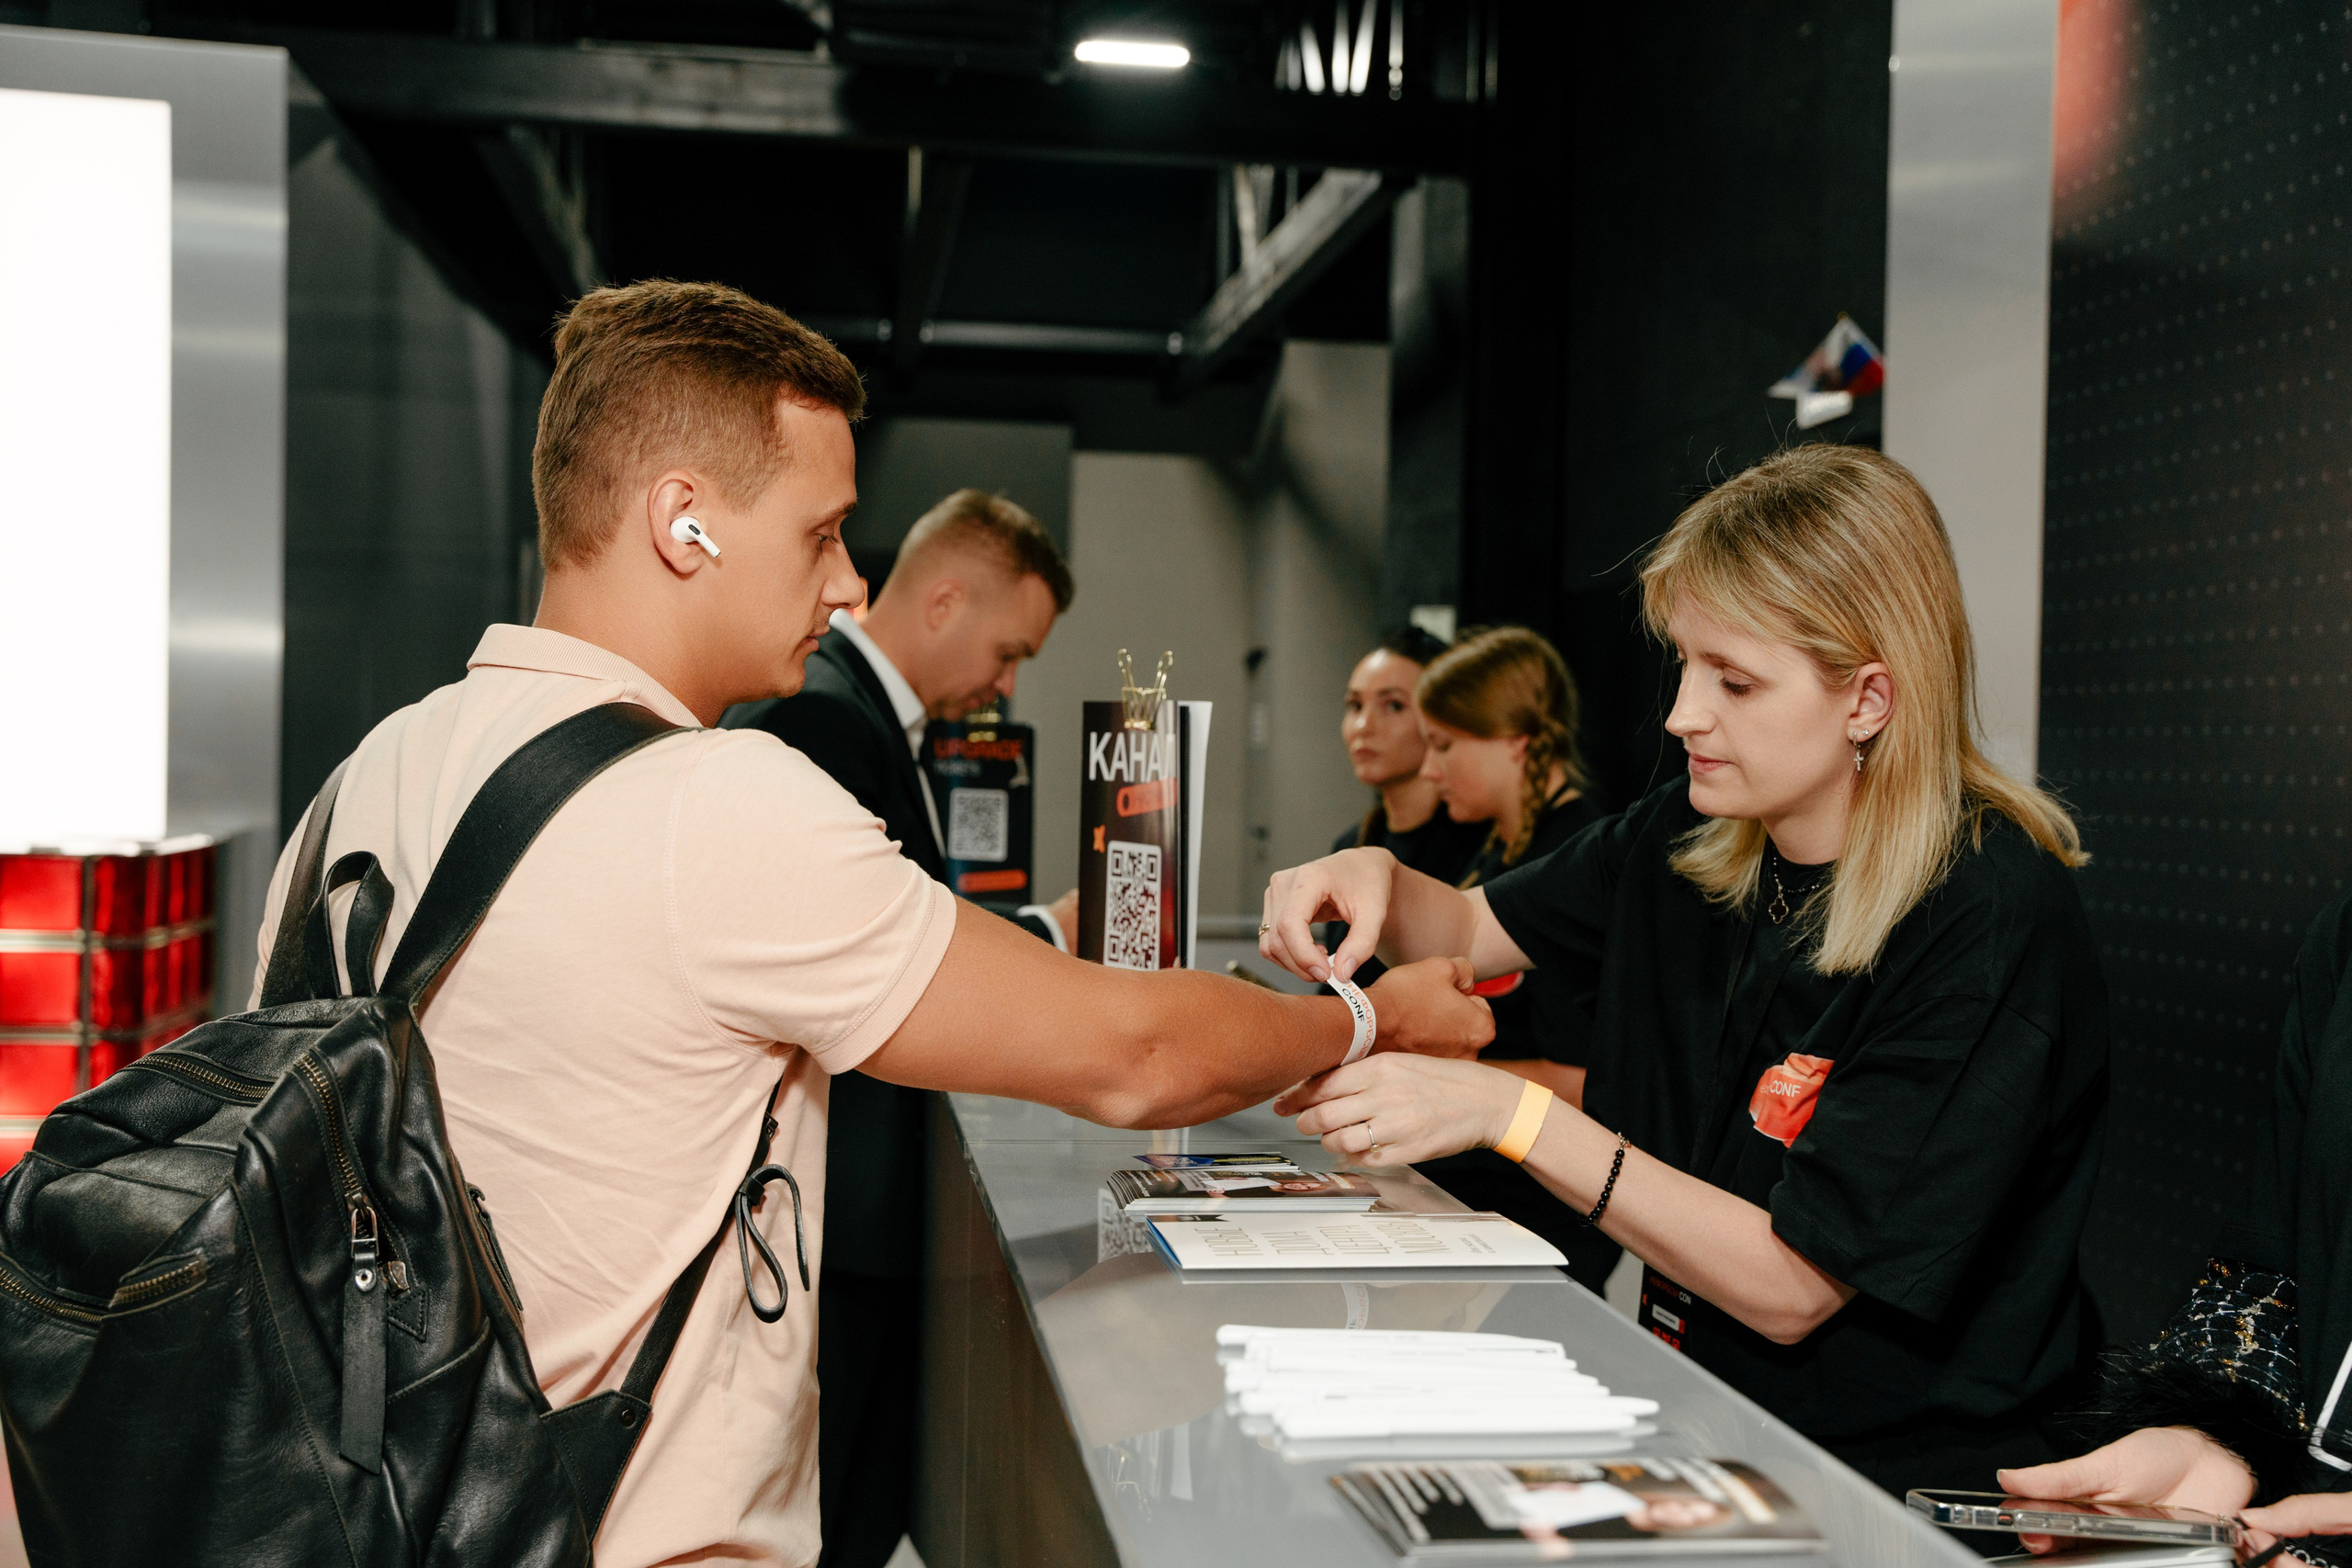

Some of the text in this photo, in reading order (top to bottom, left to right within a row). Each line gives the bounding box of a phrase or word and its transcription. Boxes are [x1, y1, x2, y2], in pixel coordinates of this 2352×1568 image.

[1341, 987, 1365, 1022] CONF
[1770, 1079, 1802, 1098] CONF
[1194, 1227, 1264, 1257] НОВЫЕ
[1261, 1231, 1335, 1256] ДОМА
[1315, 1224, 1393, 1255] ЦЕНТРА
[1367, 1220, 1453, 1254] МОСКВЫ
[1679, 1292, 1691, 1304] CON
